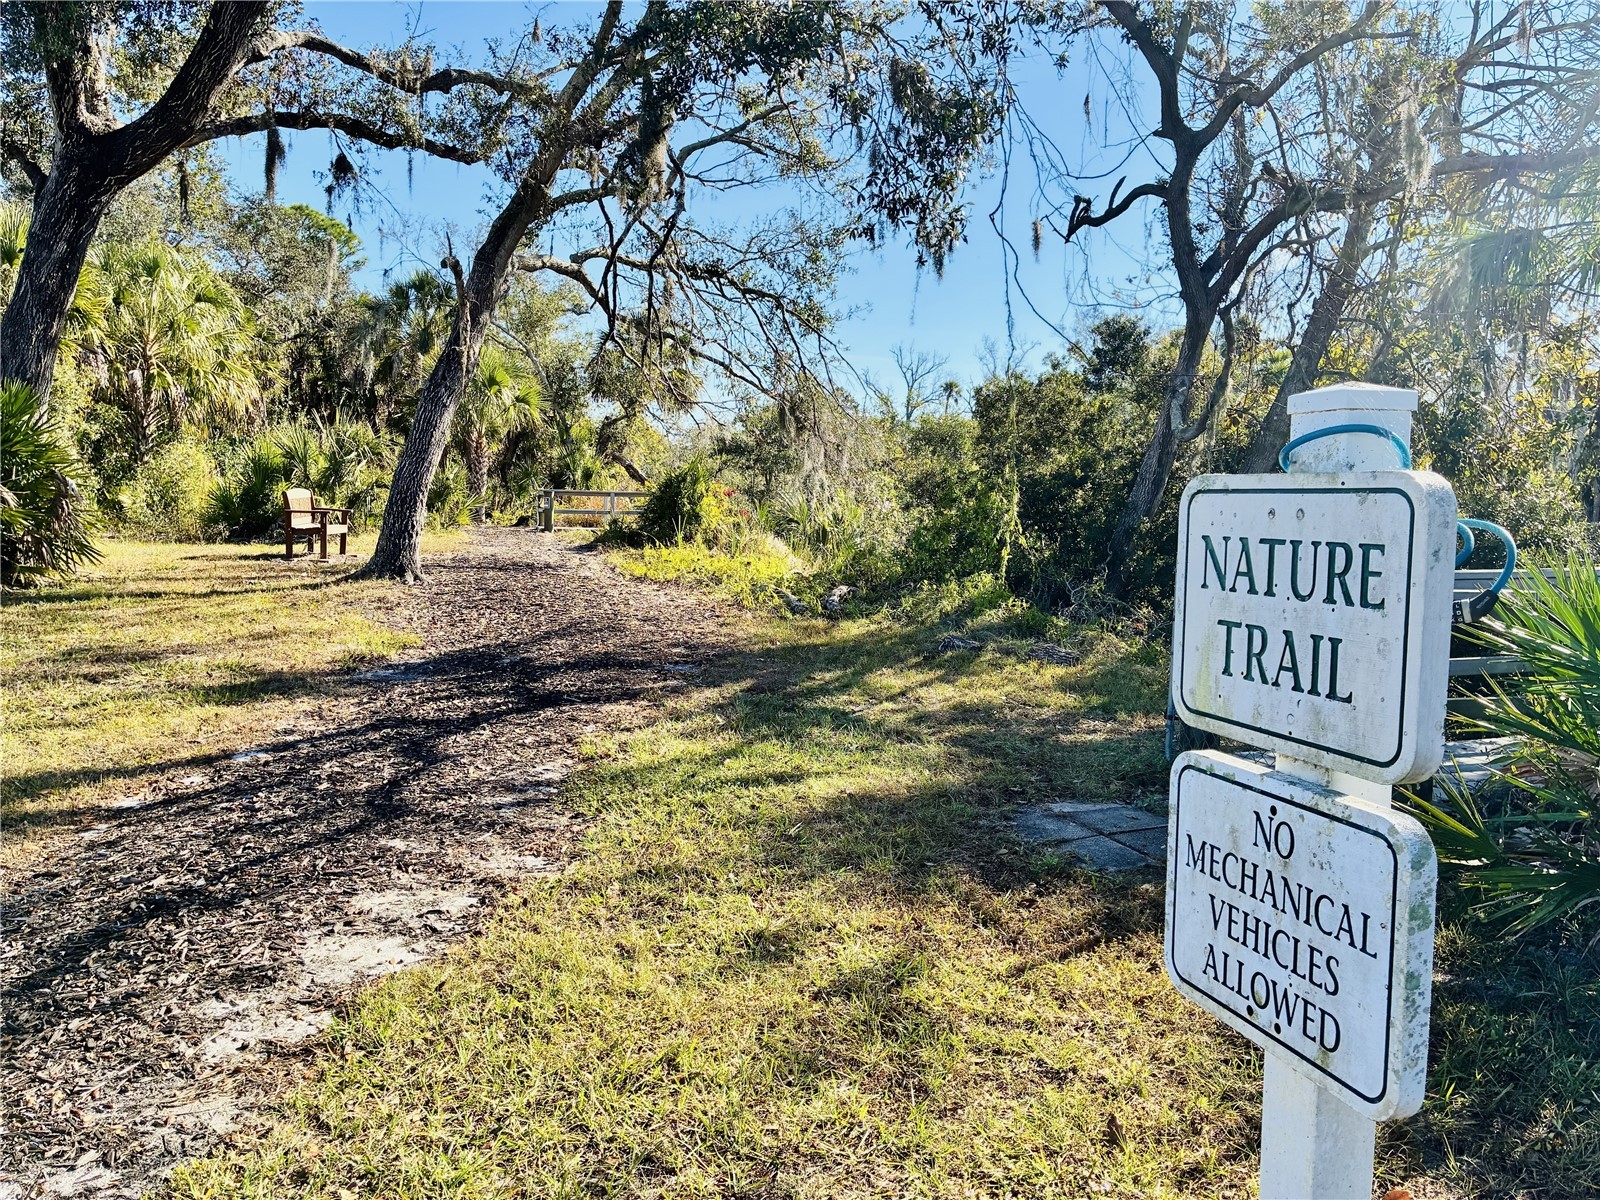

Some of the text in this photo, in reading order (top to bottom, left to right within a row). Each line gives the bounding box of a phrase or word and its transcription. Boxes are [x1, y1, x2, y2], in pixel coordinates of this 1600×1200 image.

[1200, 534, 1386, 610] NATURE
[1216, 619, 1353, 704] TRAIL
[1252, 810, 1295, 860] NO
[1185, 833, 1378, 960] MECHANICAL
[1208, 893, 1340, 997] VEHICLES
[1202, 943, 1341, 1053] ALLOWED
